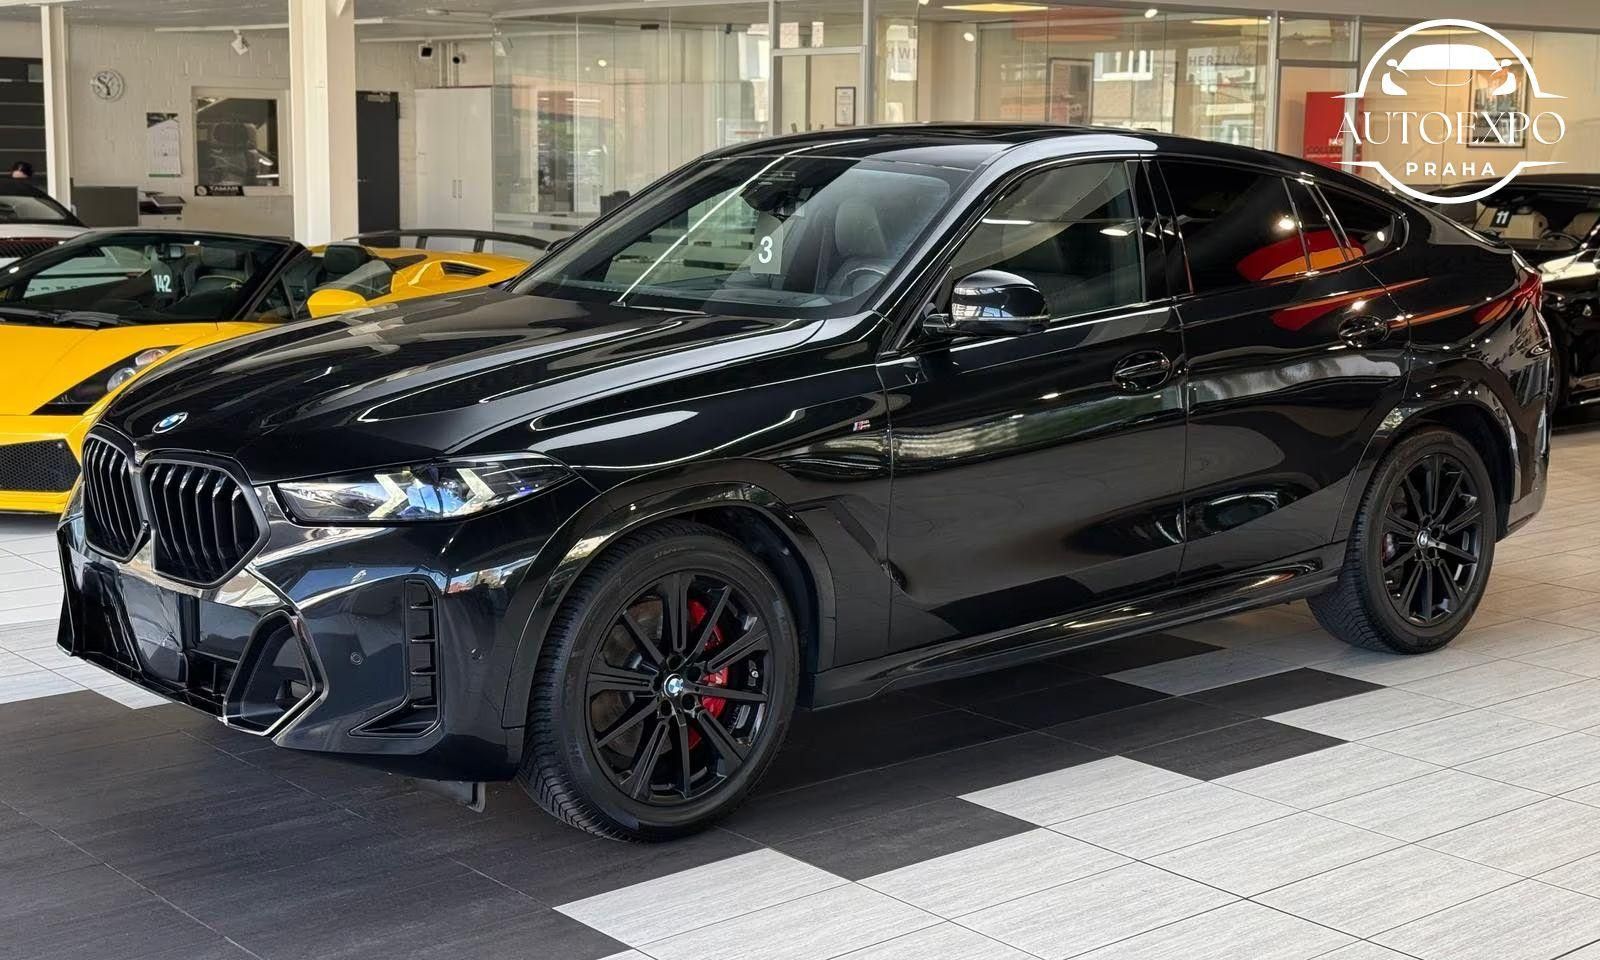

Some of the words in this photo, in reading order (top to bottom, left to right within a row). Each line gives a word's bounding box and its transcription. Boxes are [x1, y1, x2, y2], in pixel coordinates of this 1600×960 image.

[1496, 211, 1509, 224] 11
[758, 235, 773, 264] 3
[154, 275, 172, 292] 142
